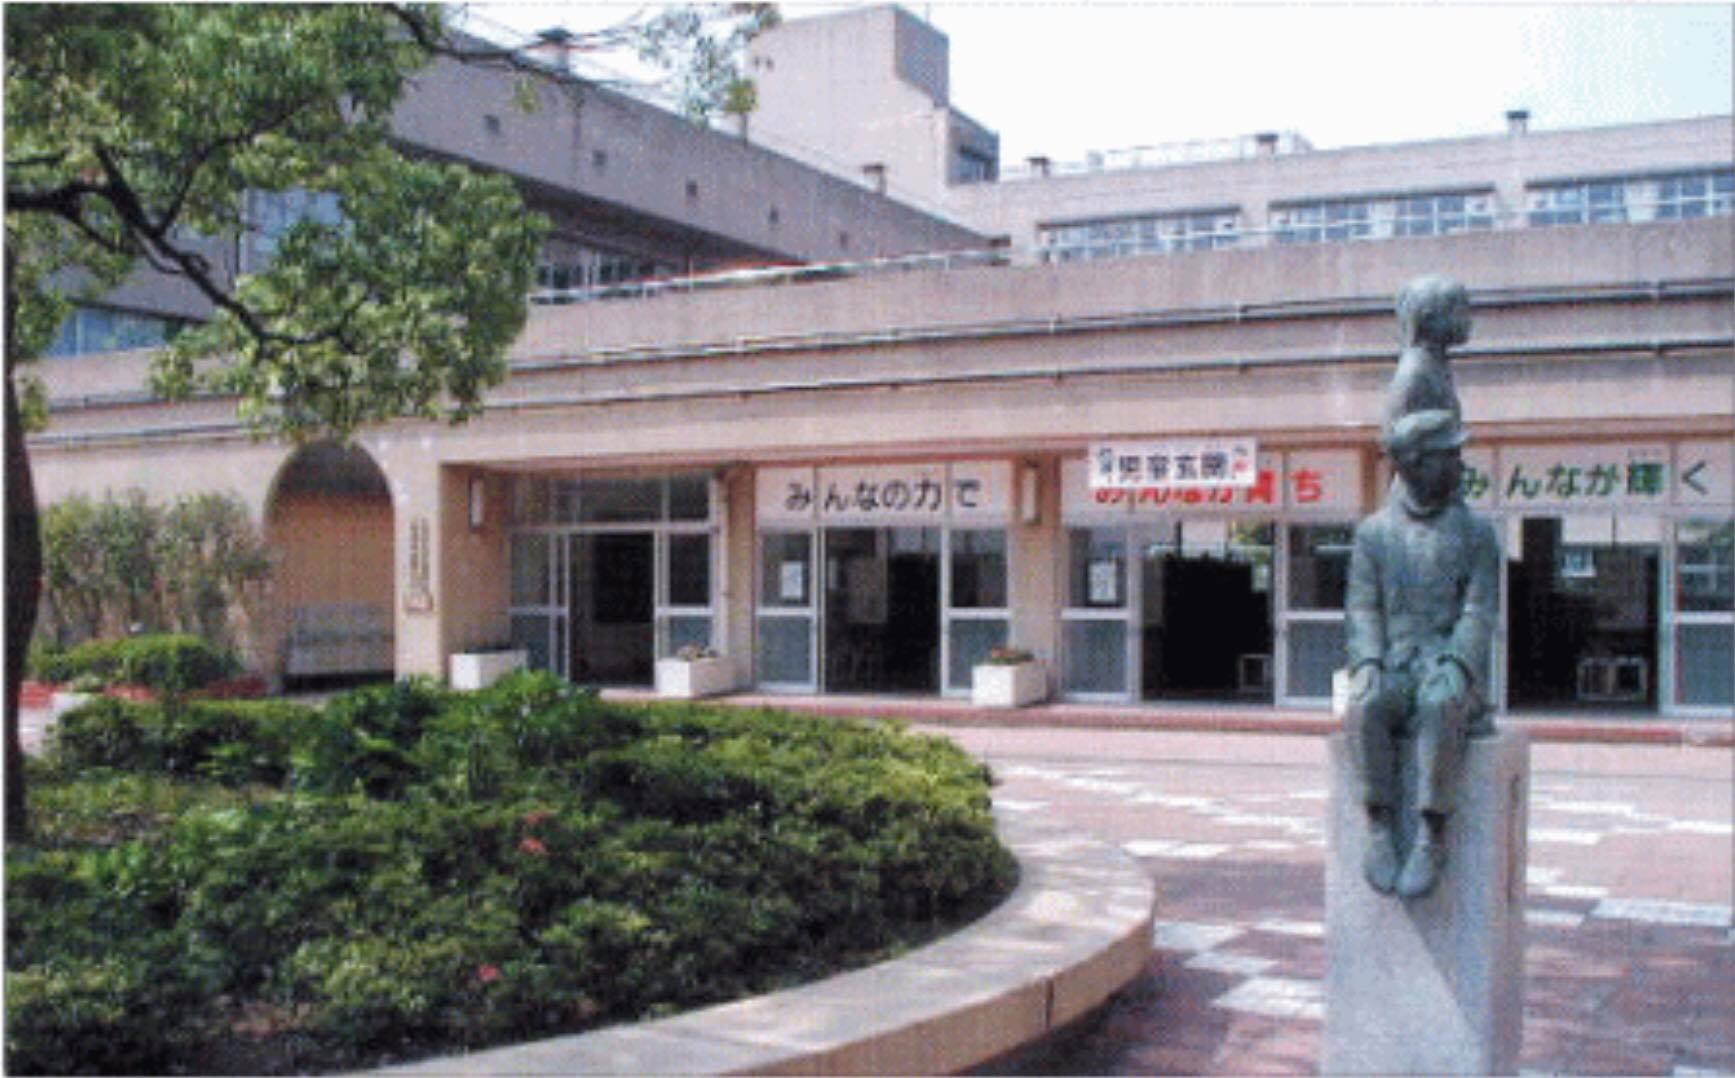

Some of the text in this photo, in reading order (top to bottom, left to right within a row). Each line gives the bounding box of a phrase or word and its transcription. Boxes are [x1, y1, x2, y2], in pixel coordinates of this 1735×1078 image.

[786, 479, 980, 511] みんなの力で
